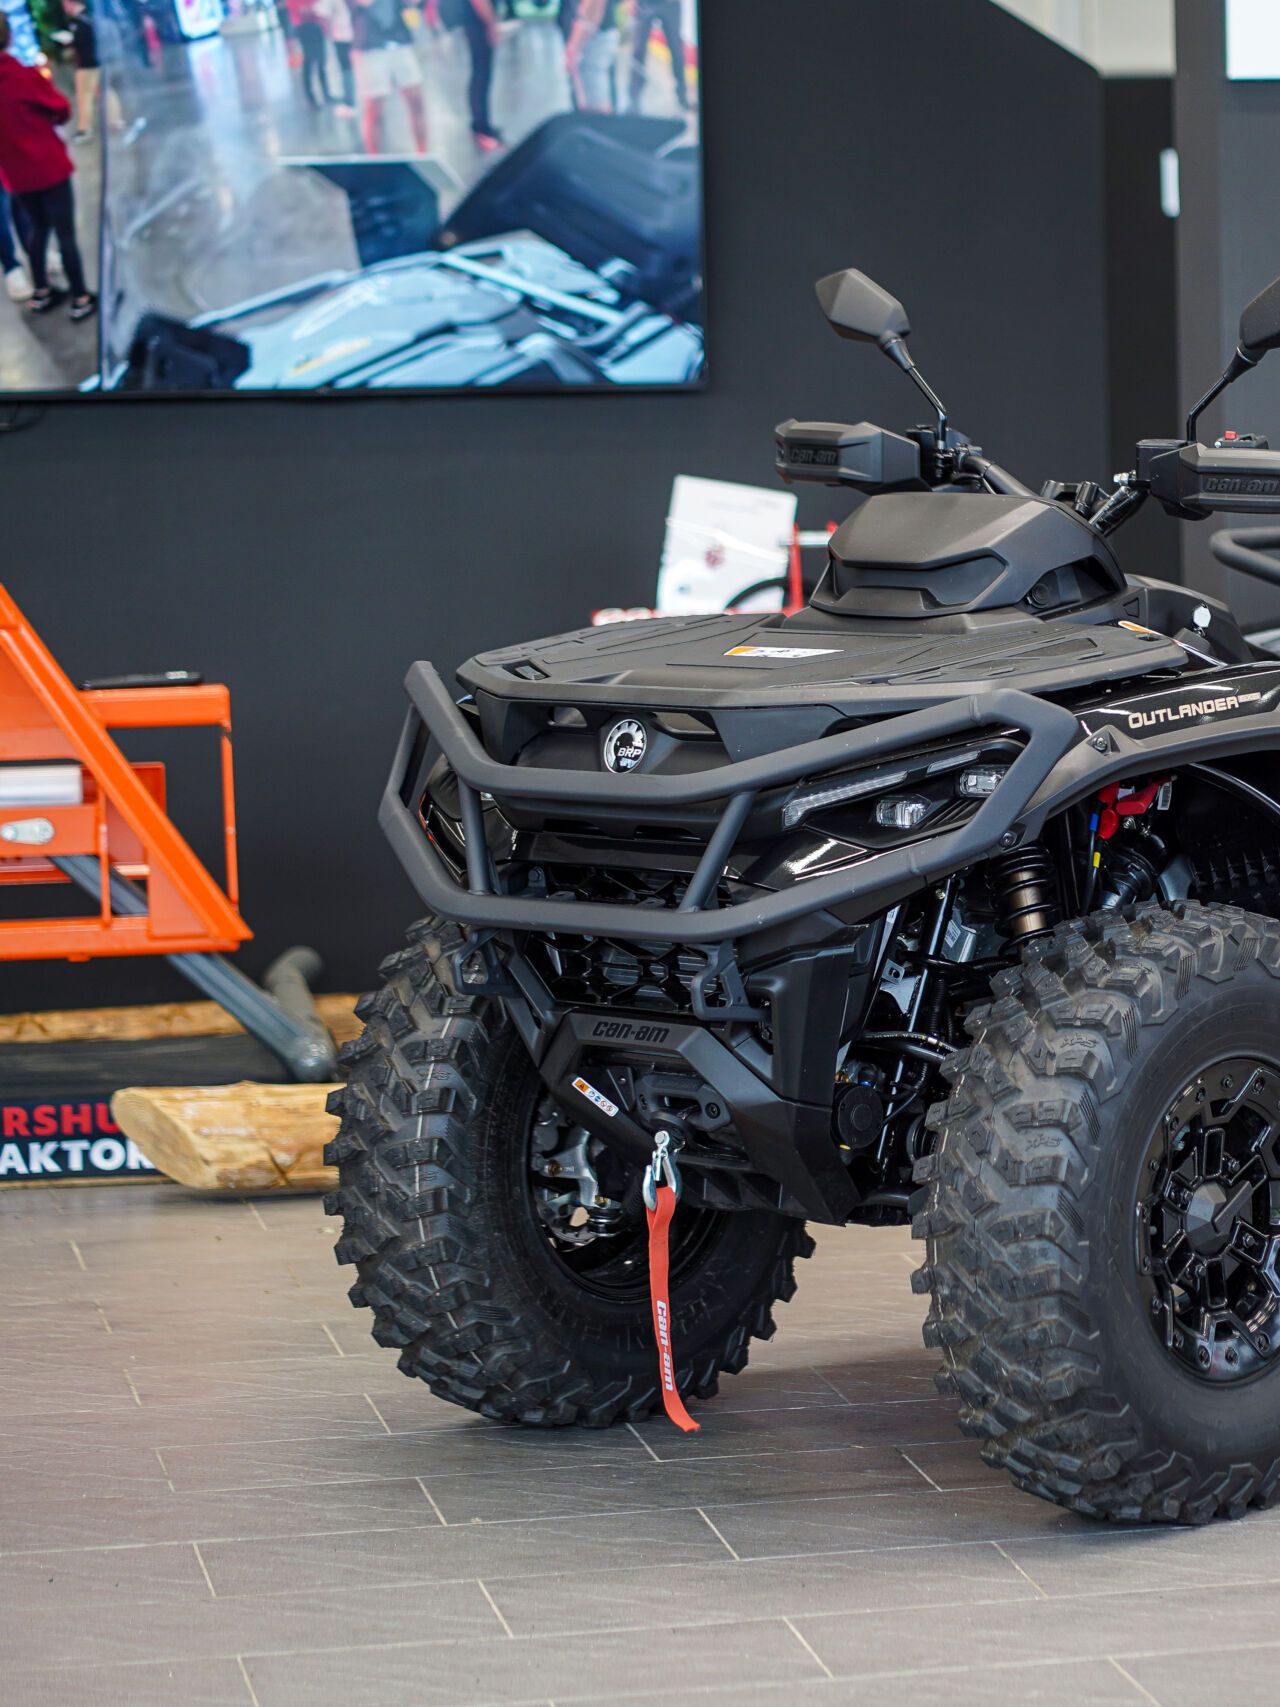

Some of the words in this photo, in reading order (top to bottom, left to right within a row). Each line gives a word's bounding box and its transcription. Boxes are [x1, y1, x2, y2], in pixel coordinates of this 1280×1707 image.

[1128, 696, 1240, 729] OUTLANDER
[617, 747, 642, 758] BRP
[592, 1021, 670, 1043] can-am
[656, 1300, 674, 1392] can-am
